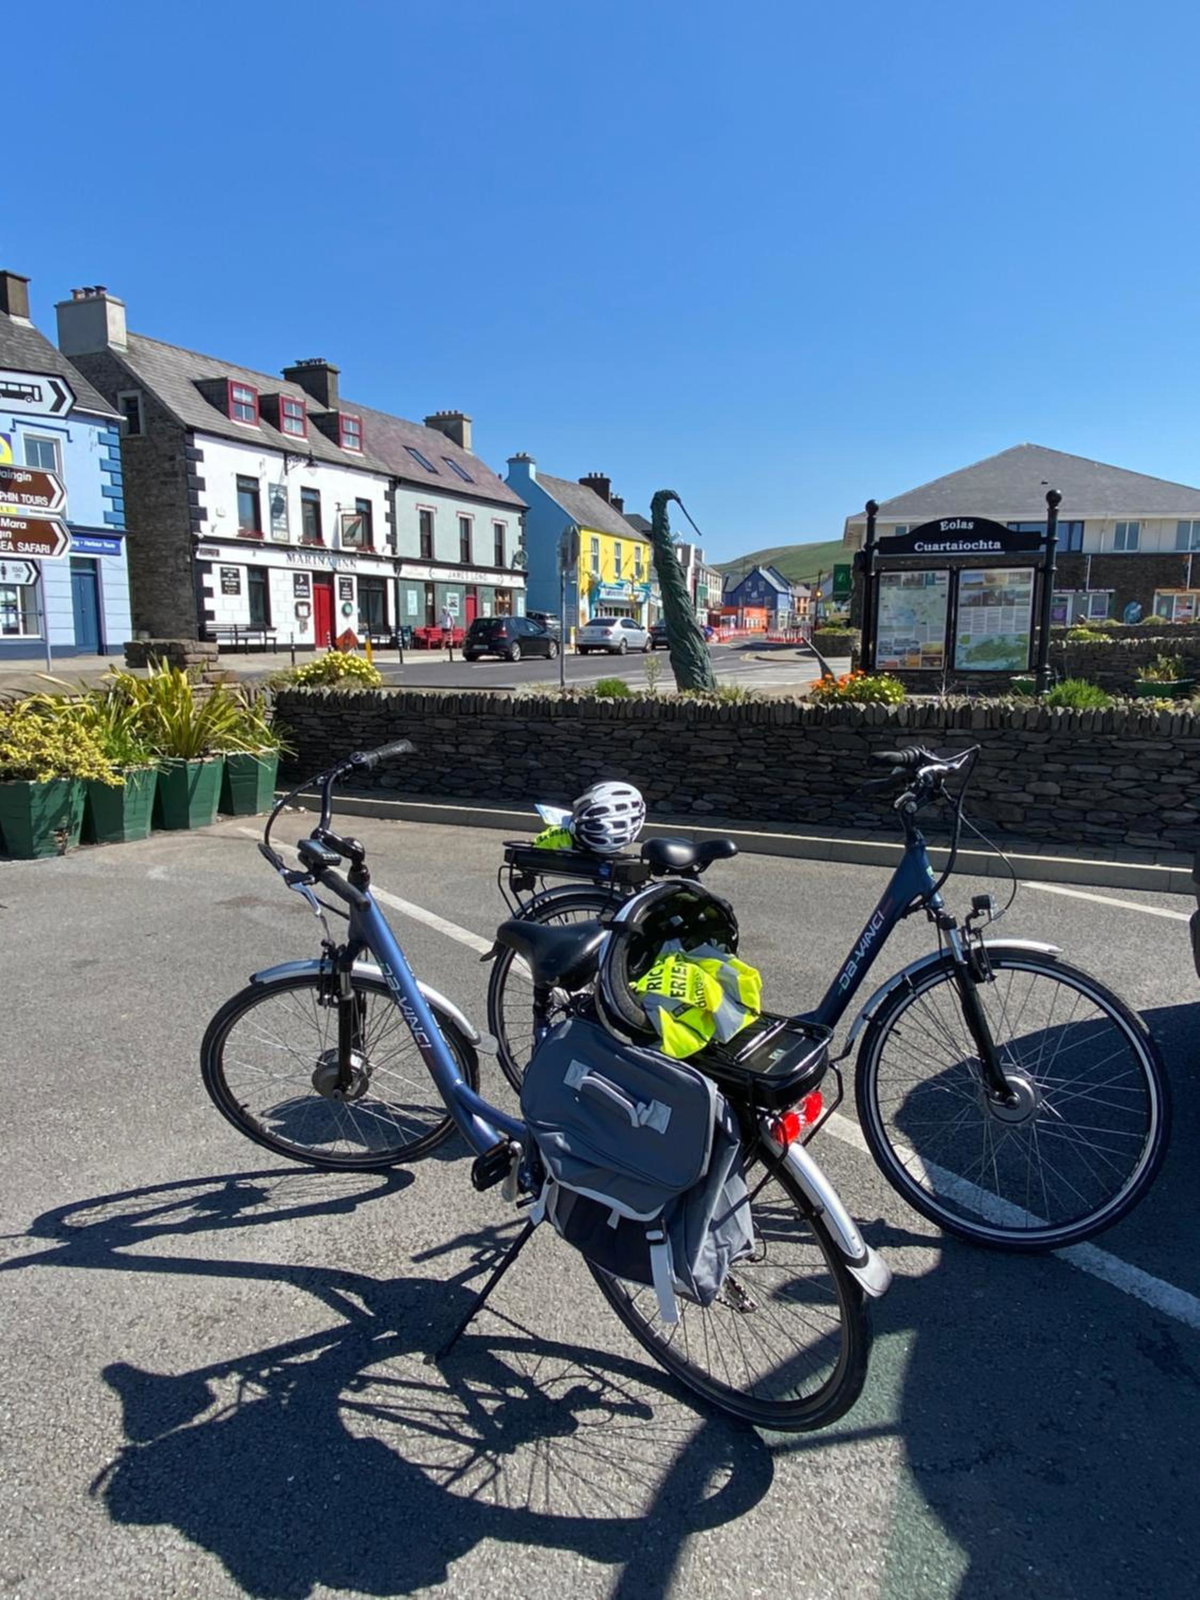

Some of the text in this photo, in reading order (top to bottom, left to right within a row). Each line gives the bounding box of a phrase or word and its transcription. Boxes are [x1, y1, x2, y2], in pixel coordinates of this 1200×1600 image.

[20, 494, 49, 506] TOURS
[0, 518, 27, 529] Mara
[940, 519, 975, 531] Eolas
[17, 542, 51, 554] SAFARI
